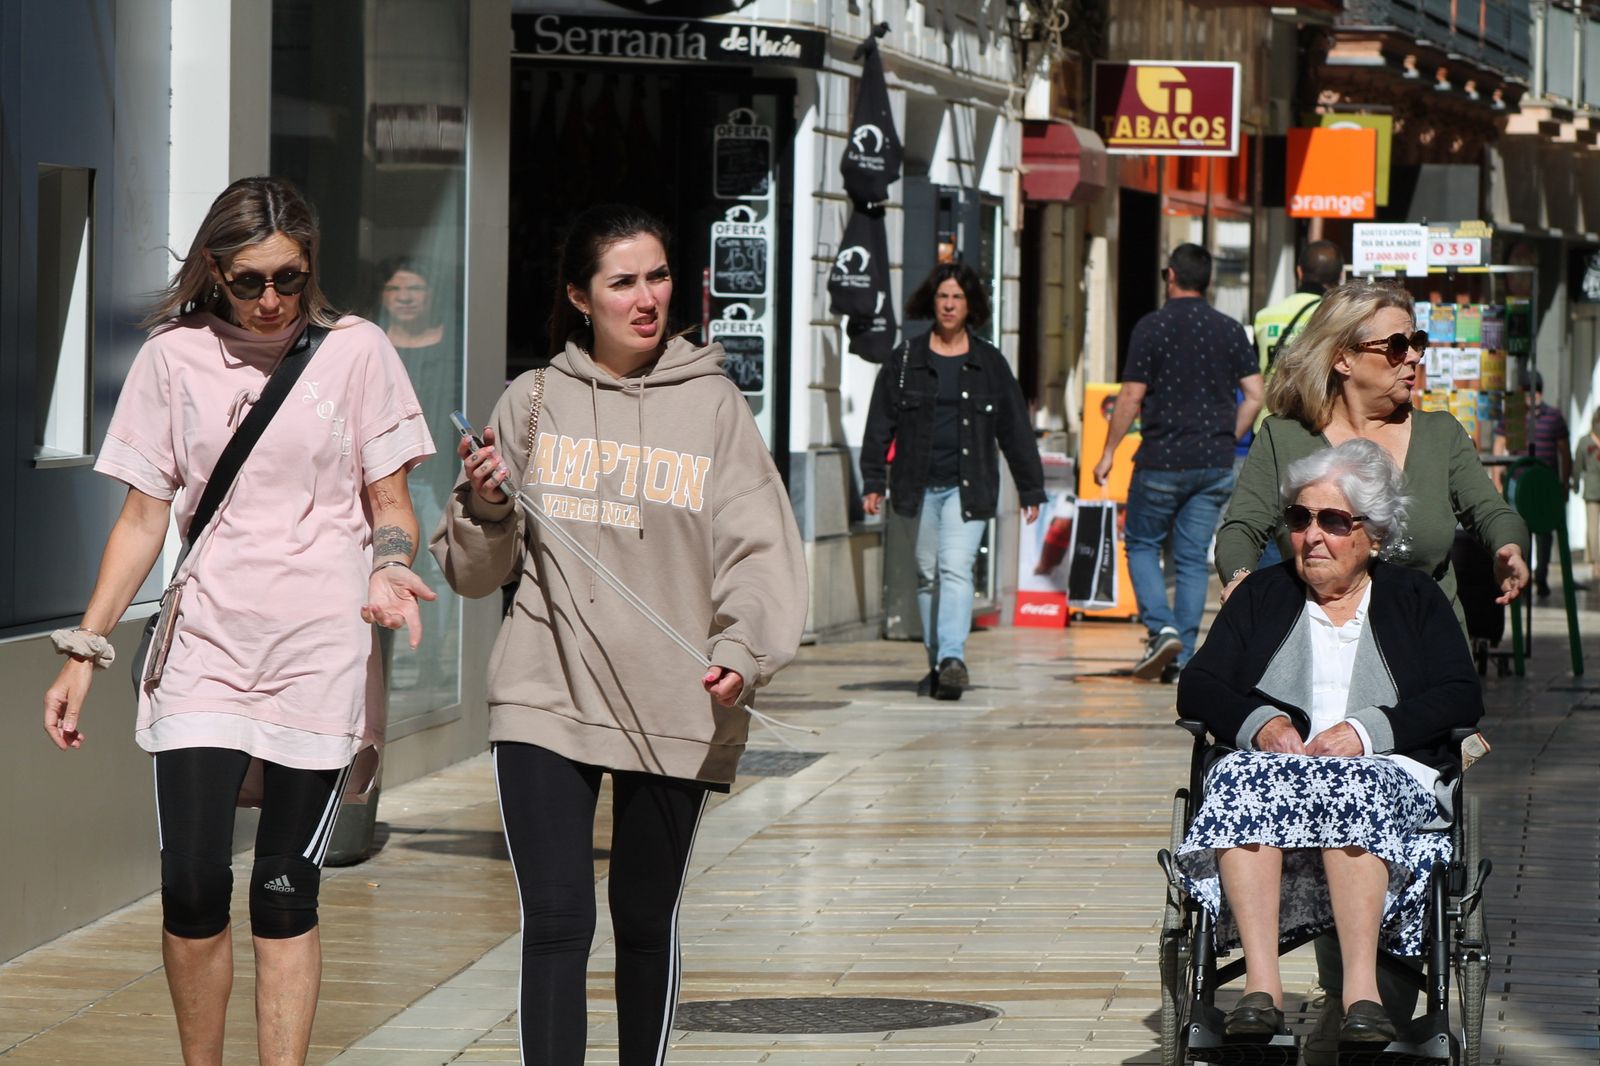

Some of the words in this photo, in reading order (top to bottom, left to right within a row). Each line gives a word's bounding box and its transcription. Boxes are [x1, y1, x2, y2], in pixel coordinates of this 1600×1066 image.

[534, 15, 708, 60] Serranía
[720, 27, 748, 51] de
[717, 125, 769, 137] OFERTA
[1102, 115, 1227, 140] TABACOS
[1290, 193, 1366, 217] orange
[715, 224, 767, 236] OFERTA
[712, 322, 764, 333] OFERTA
[524, 432, 712, 511] AMPTON
[542, 493, 641, 529] VIRGINIA
[264, 883, 295, 893] adidas
